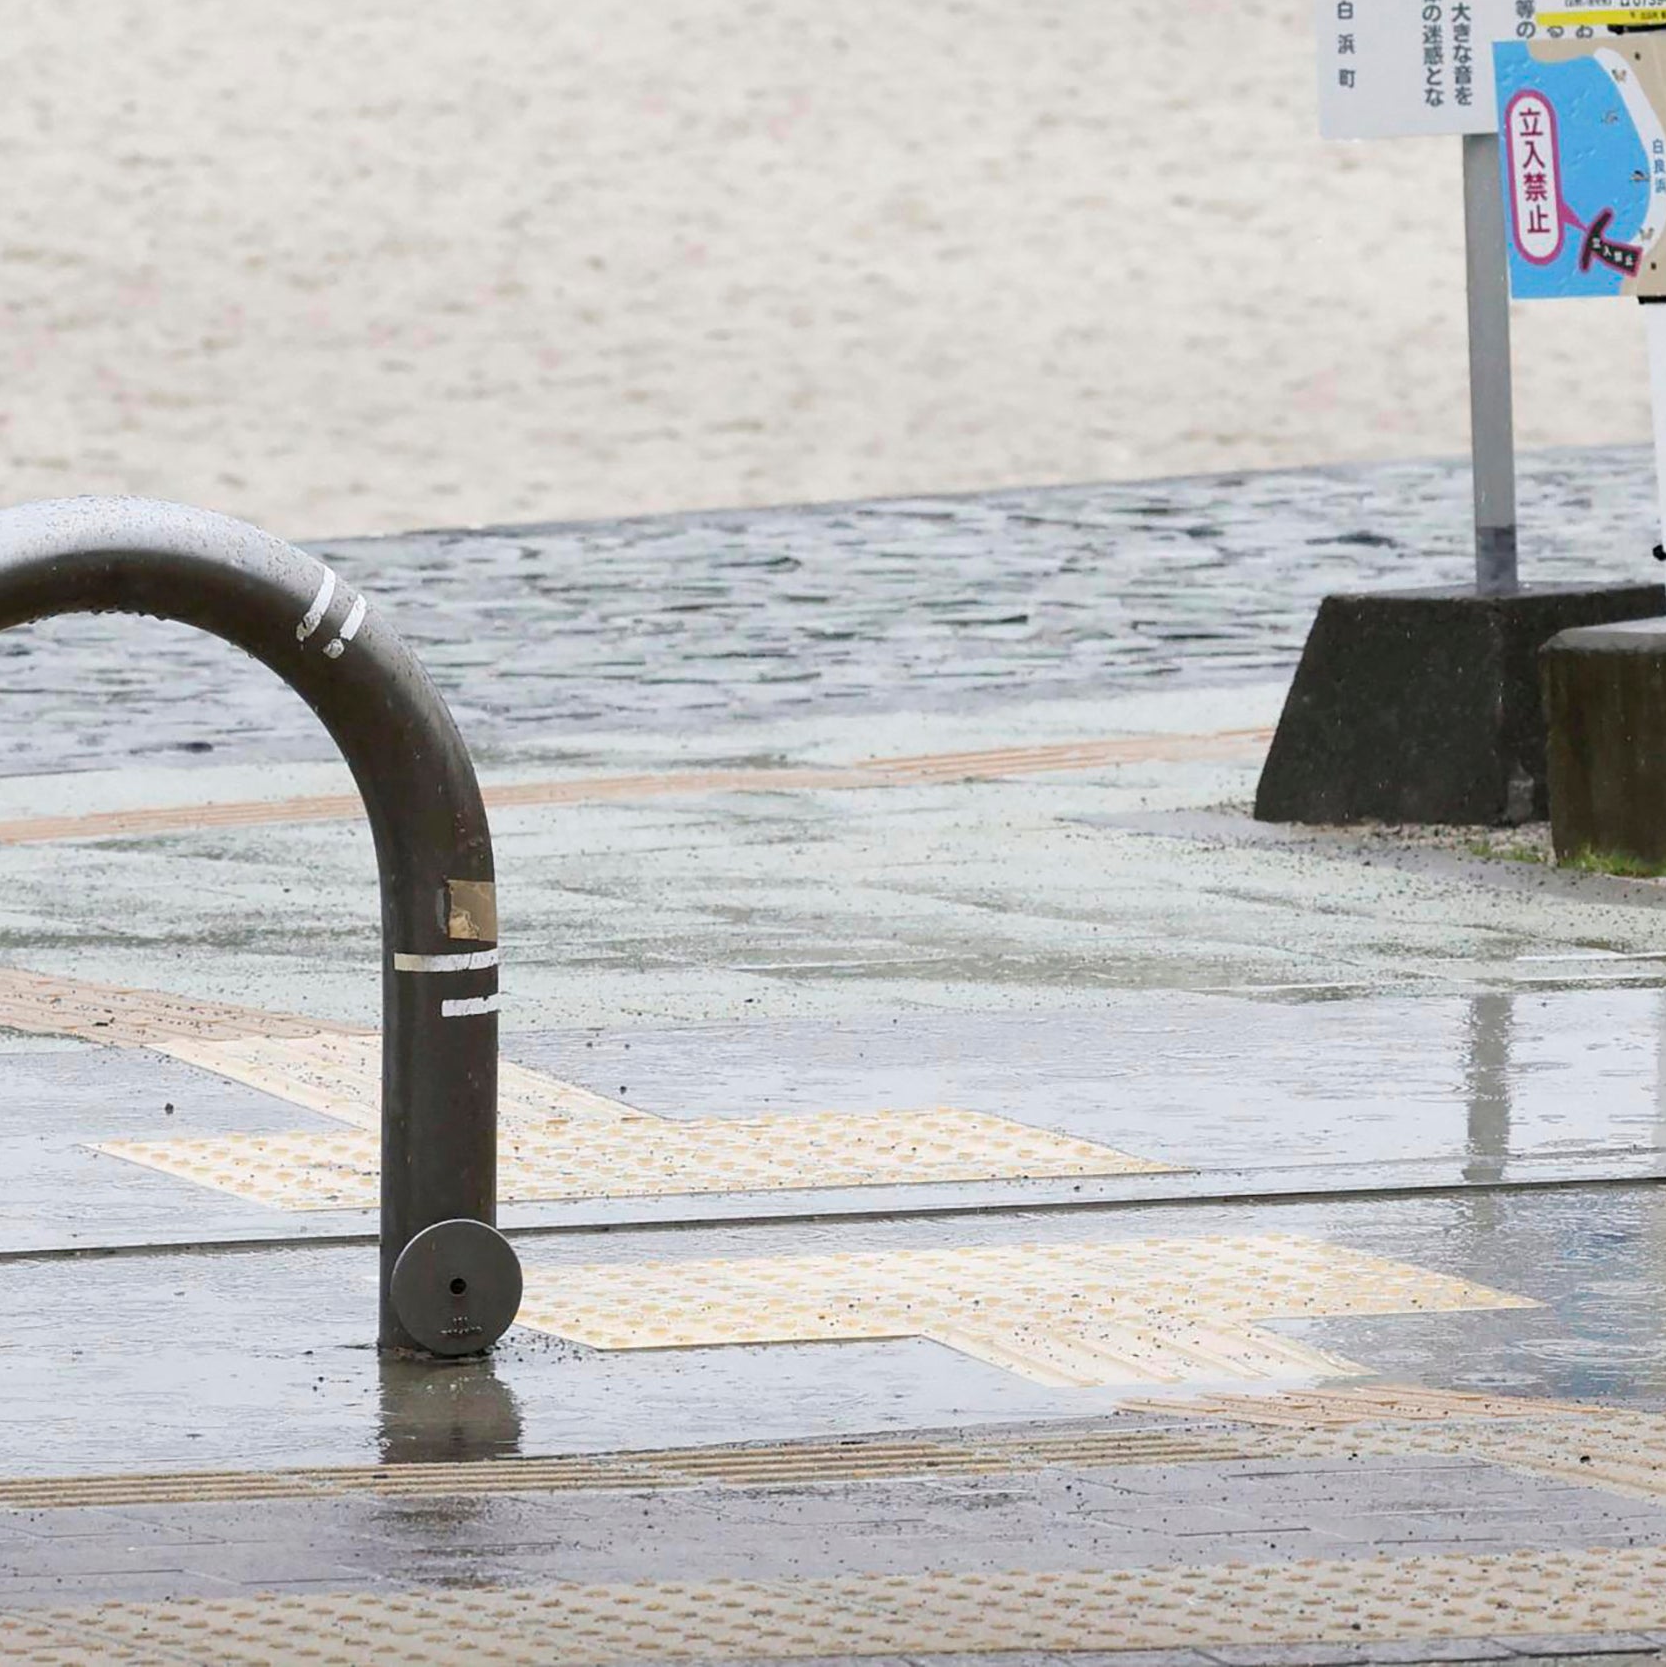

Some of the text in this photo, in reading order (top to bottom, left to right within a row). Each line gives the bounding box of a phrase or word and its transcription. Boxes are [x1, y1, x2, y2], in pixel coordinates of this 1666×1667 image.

[1337, 1, 1355, 88] 白浜町
[1519, 108, 1552, 235] 立入禁止
